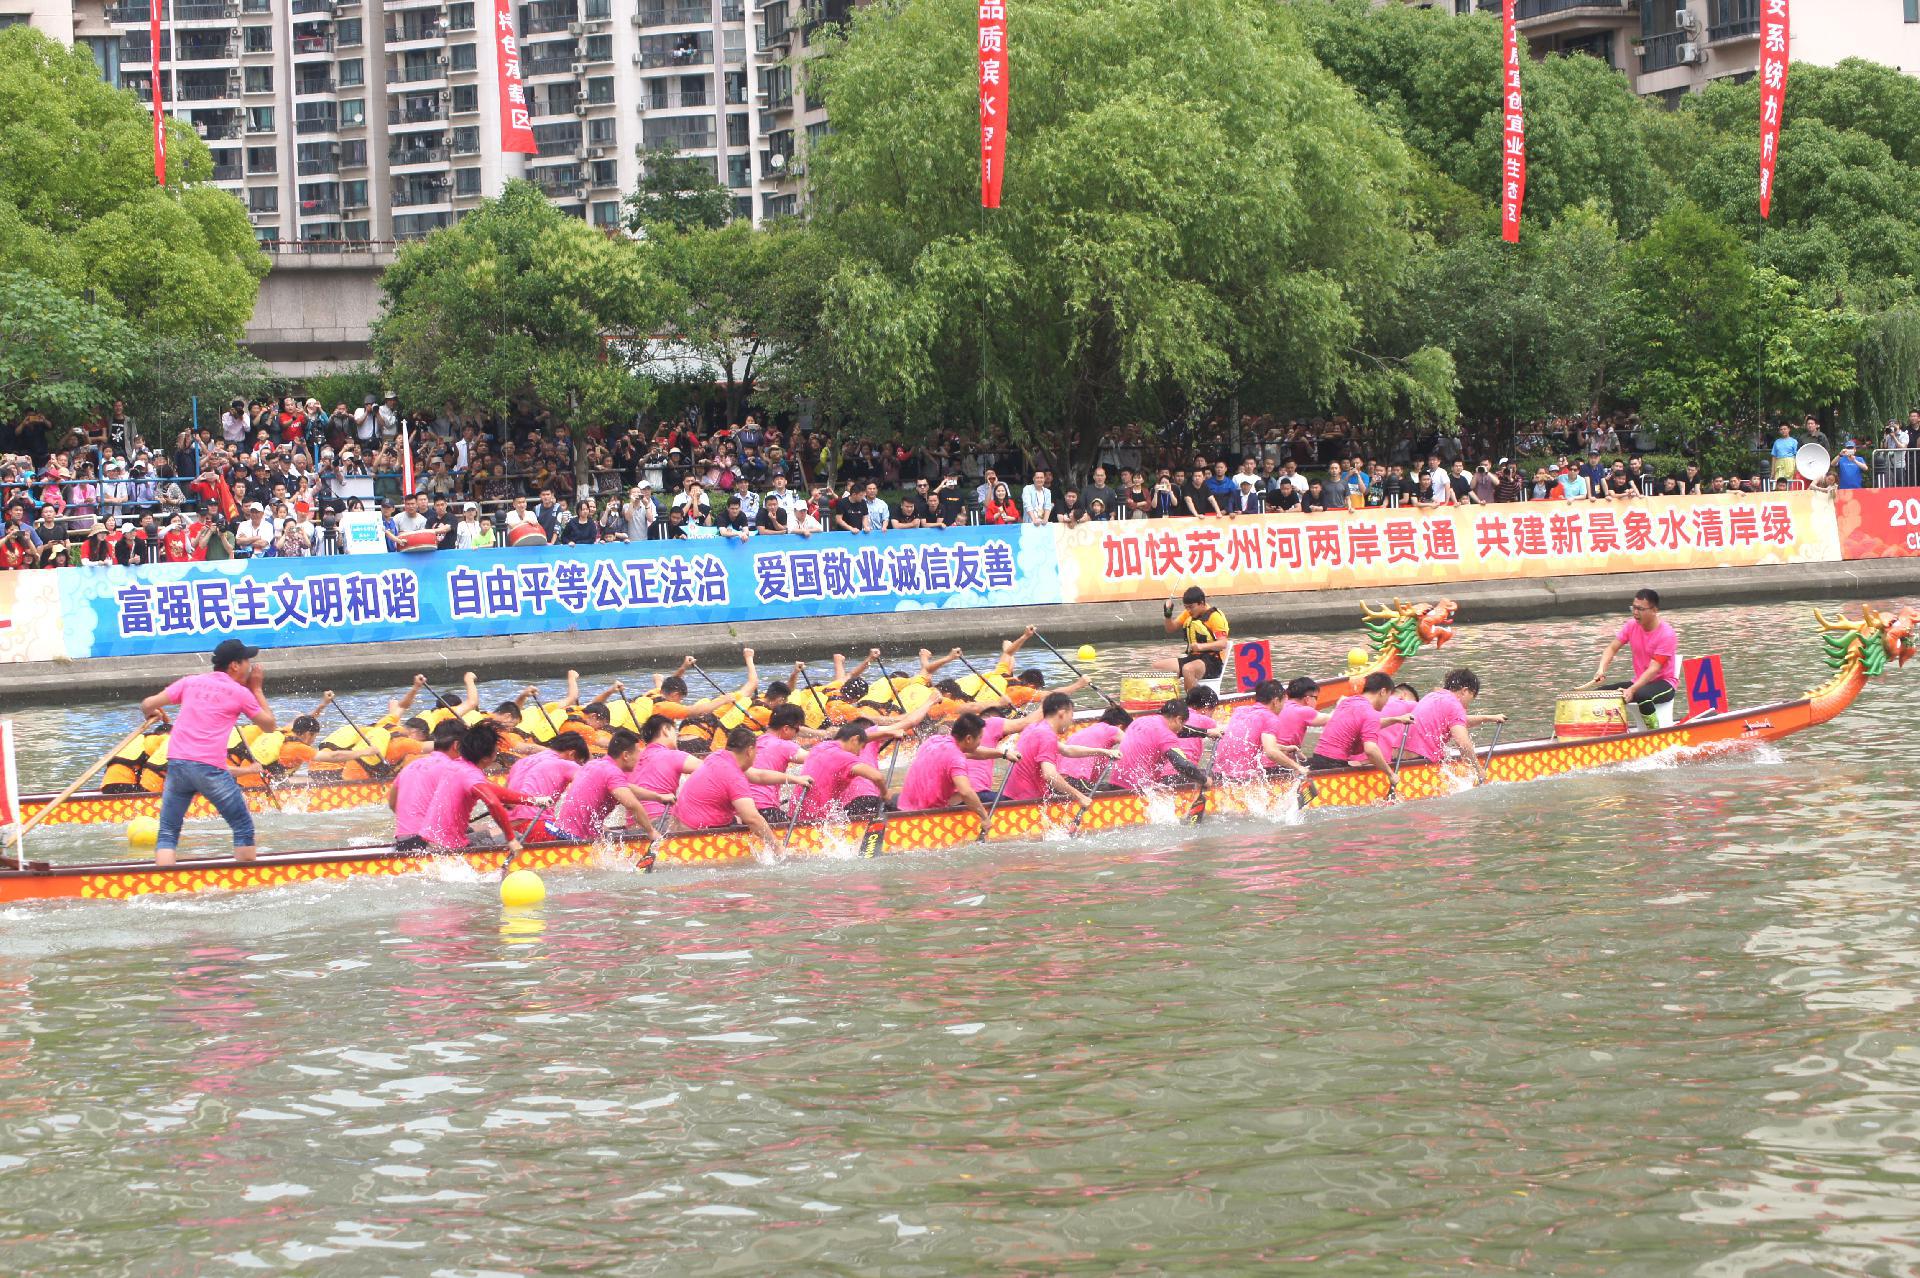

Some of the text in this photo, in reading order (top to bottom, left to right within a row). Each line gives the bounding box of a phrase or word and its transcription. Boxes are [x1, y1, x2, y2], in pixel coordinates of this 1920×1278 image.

[1103, 519, 1459, 577] 加快苏州河两岸贯通
[1476, 505, 1794, 559] 共建新景象水清岸绿
[450, 554, 727, 616] 自由平等公正法治
[756, 541, 1014, 600] 爱国敬业诚信友善
[117, 572, 417, 634] 富强民主文明和谐
[1240, 642, 1267, 688] 3
[1693, 658, 1722, 709] 4
